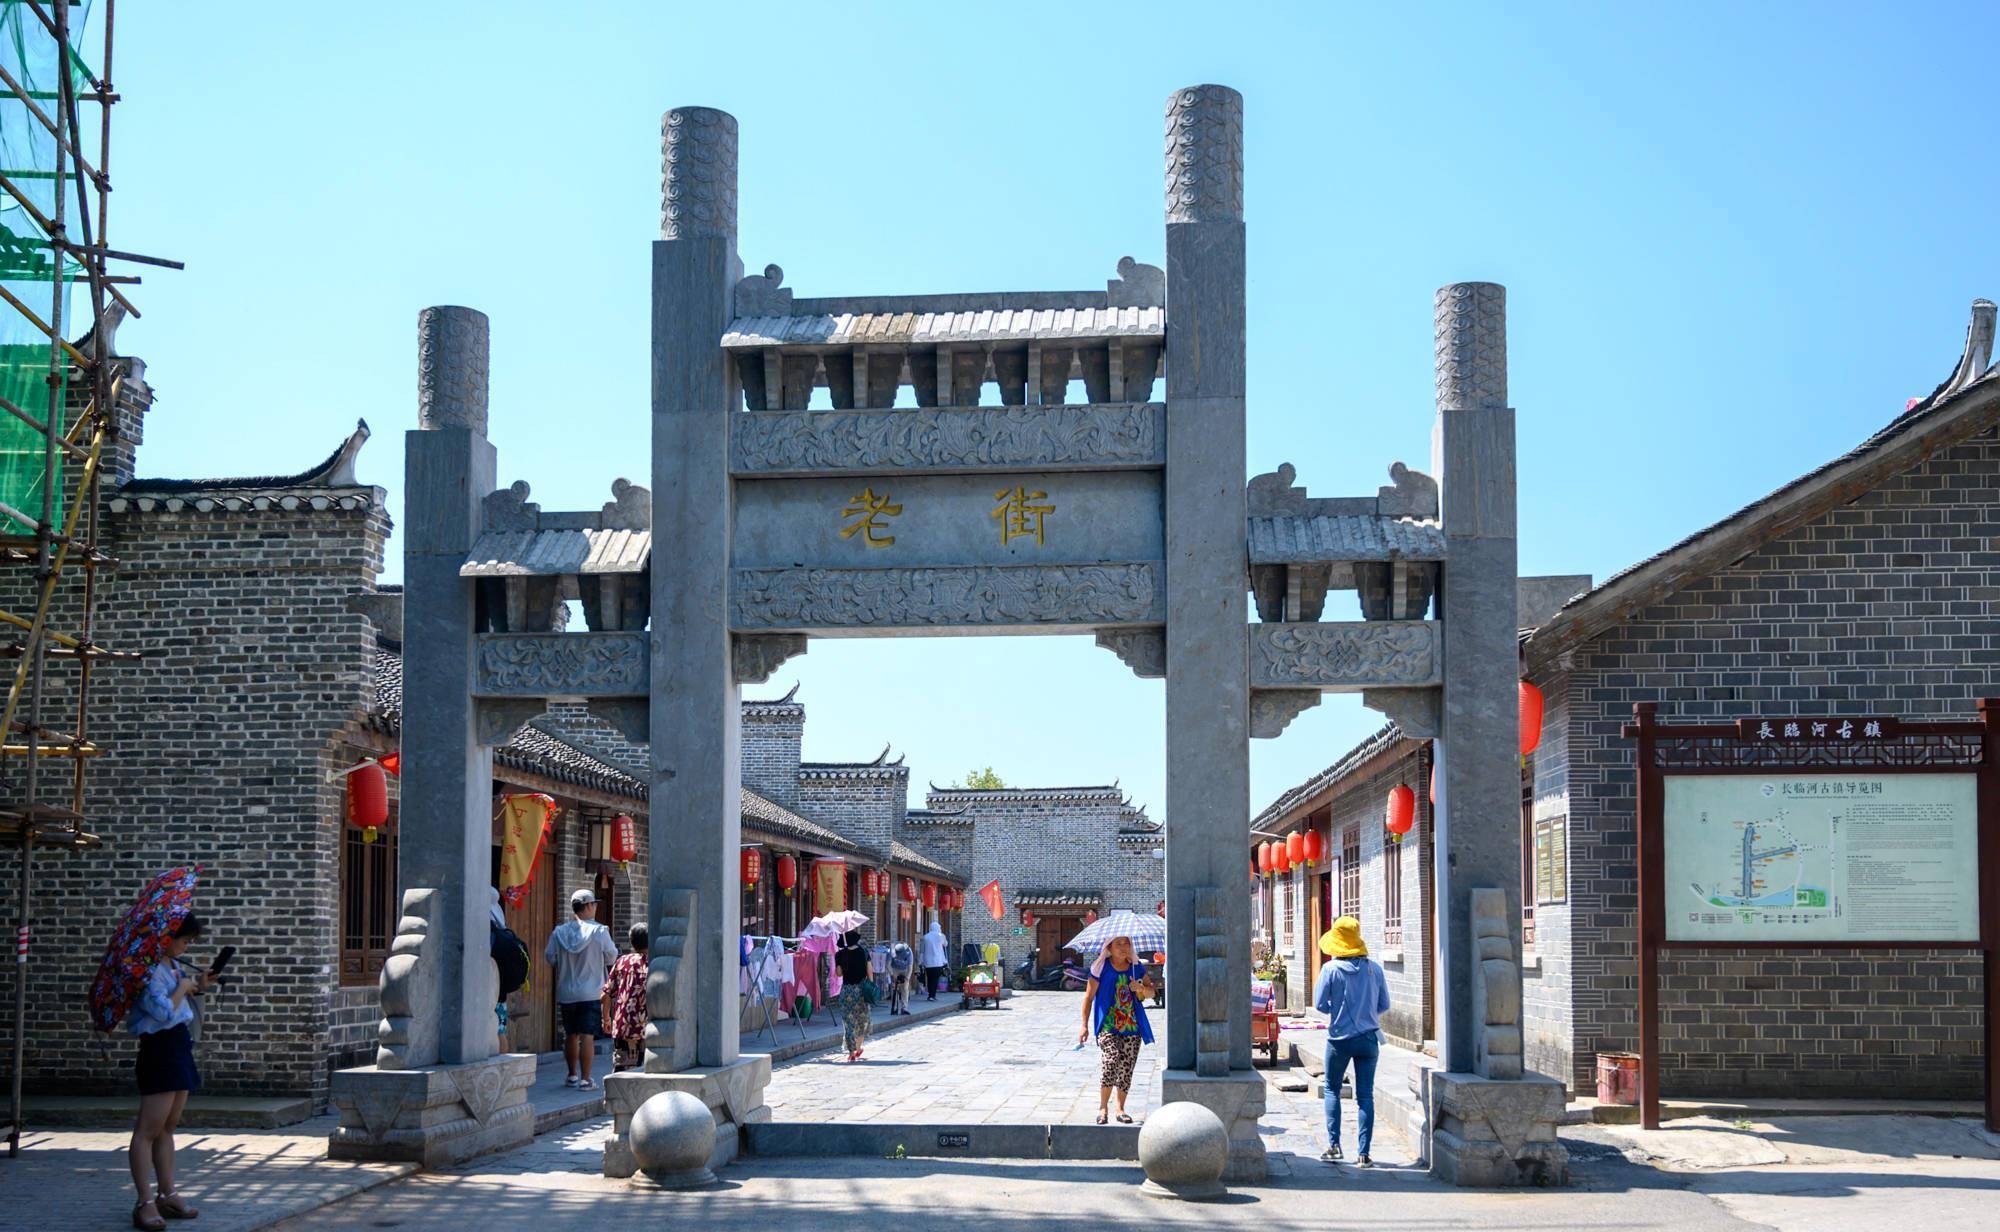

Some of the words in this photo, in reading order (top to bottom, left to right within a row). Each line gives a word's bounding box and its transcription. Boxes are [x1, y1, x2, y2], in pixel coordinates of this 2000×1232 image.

[840, 487, 1056, 547] 老街
[1756, 720, 1882, 739] 長臨河古鎮
[1782, 781, 1882, 794] 长临河古镇导览图
